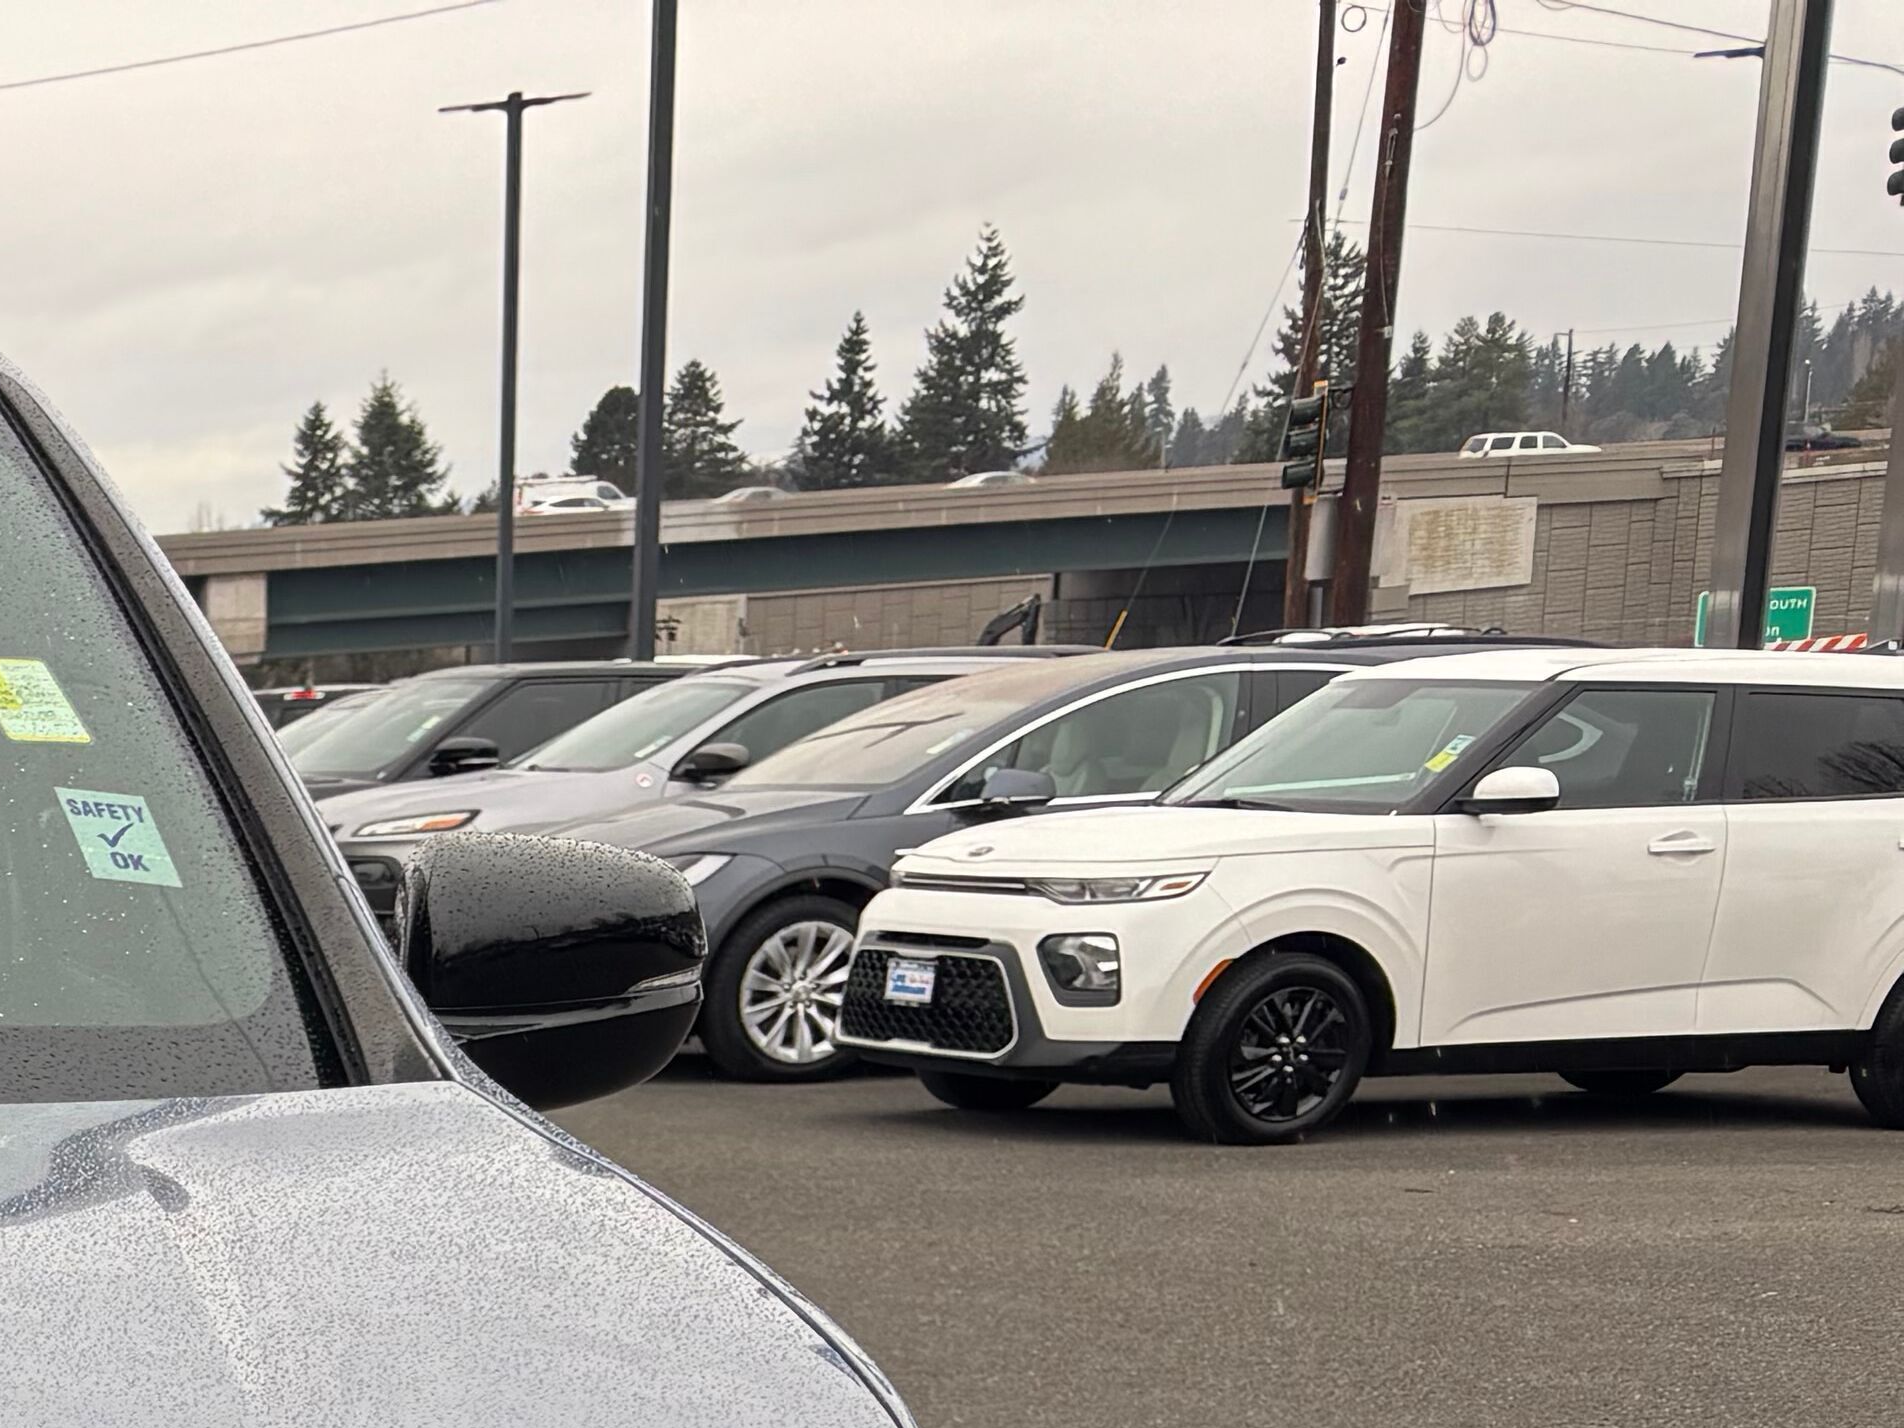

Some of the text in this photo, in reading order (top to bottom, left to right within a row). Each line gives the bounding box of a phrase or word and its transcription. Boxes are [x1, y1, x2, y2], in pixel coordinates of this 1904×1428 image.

[1769, 598, 1808, 610] OUTH
[66, 798, 144, 823] SAFETY
[110, 851, 151, 872] OK
